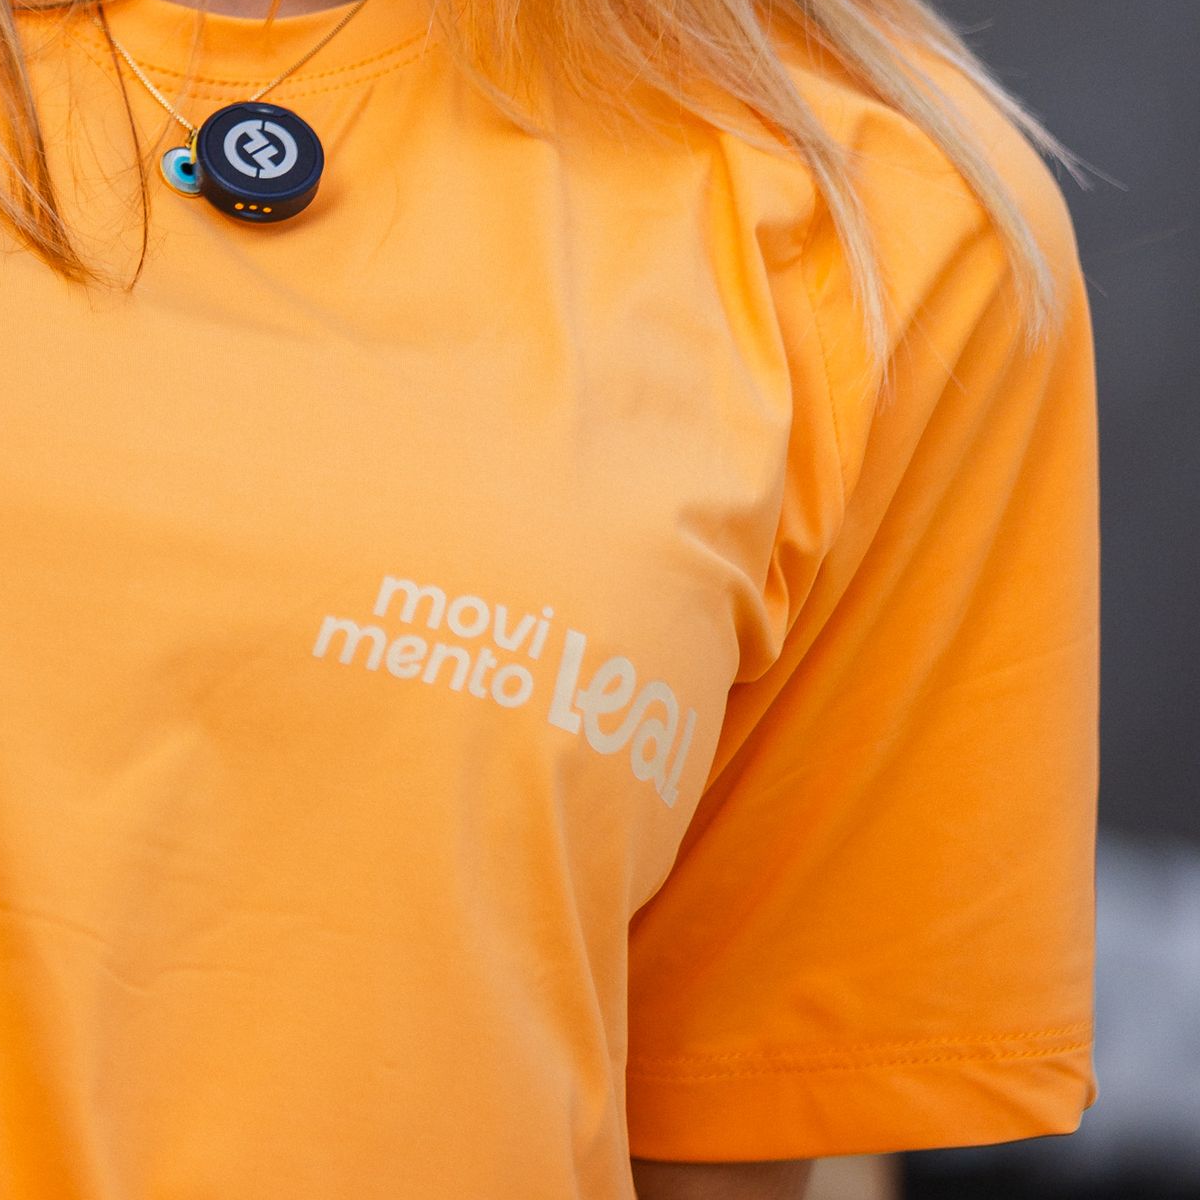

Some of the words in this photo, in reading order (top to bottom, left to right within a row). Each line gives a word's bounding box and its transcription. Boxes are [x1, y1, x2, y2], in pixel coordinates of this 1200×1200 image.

[312, 615, 534, 709] mento
[373, 574, 554, 661] movi
[548, 628, 698, 809] Leal
